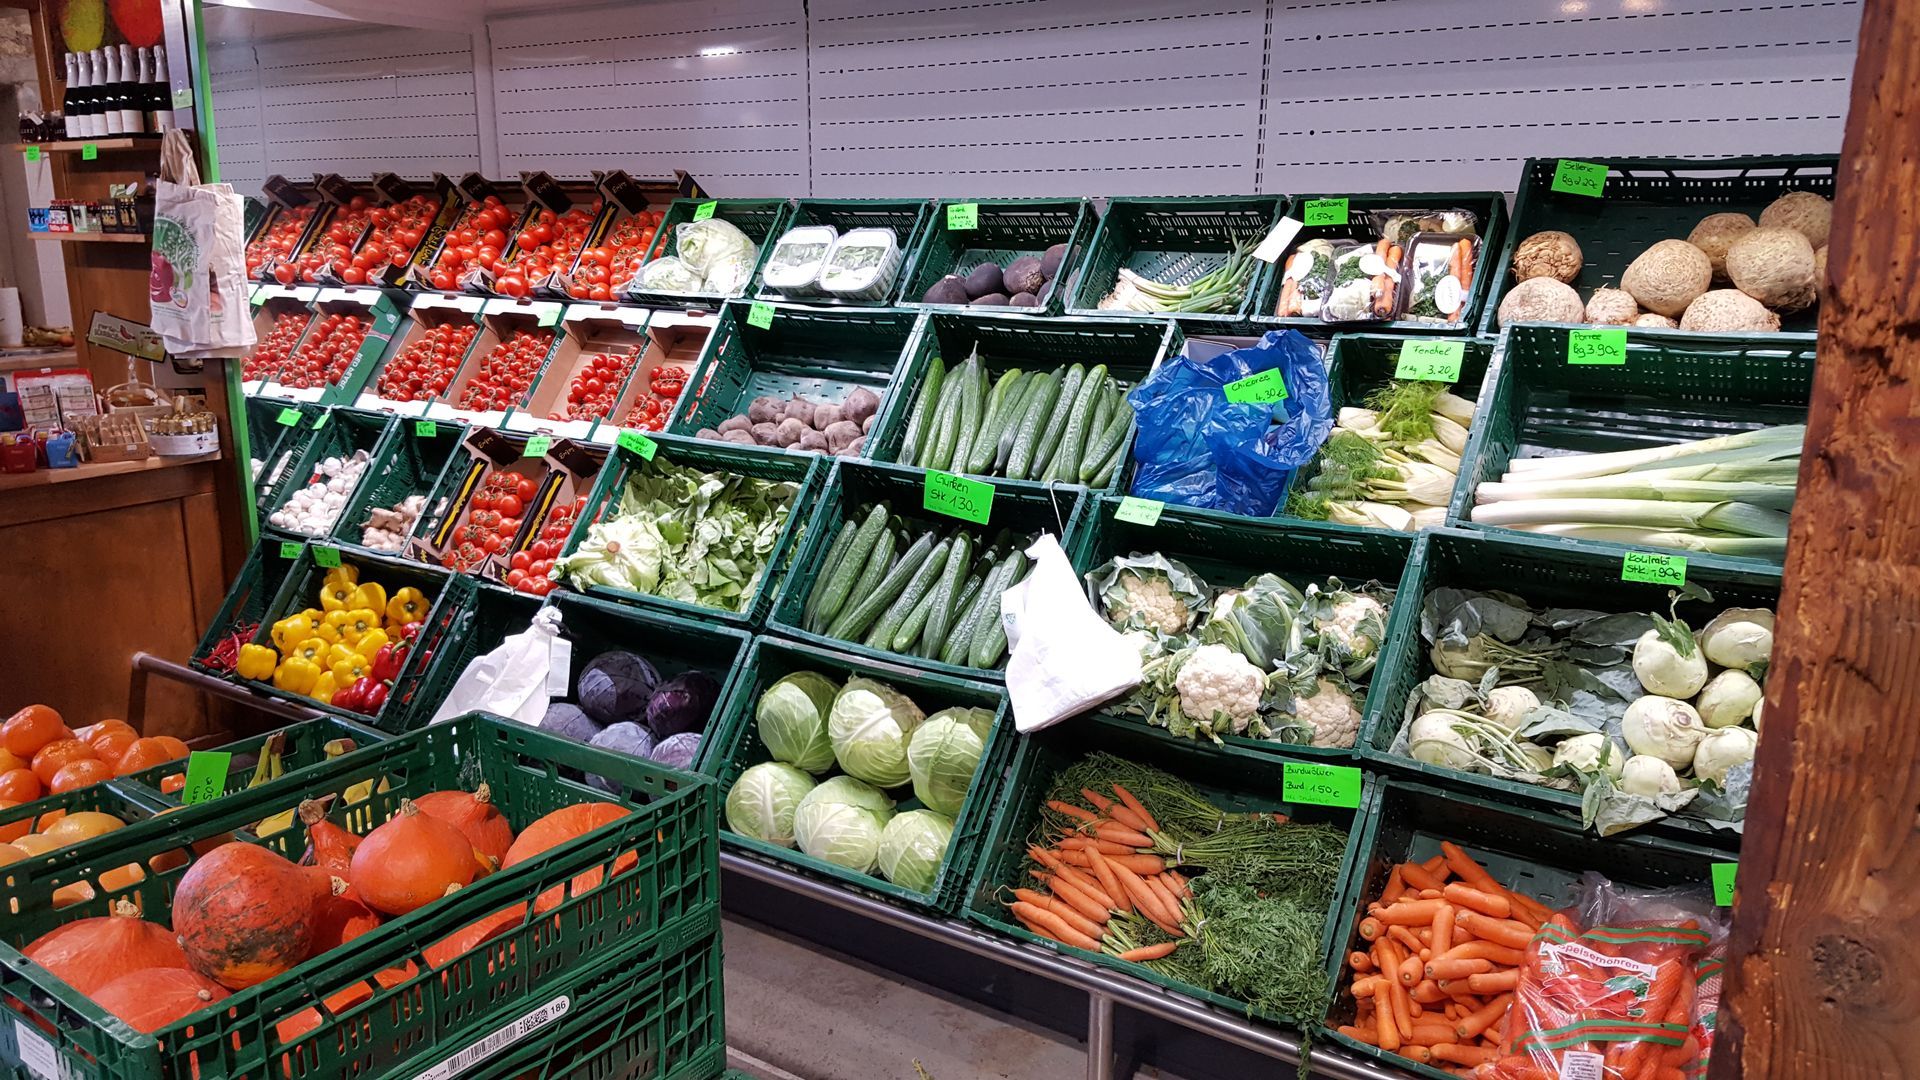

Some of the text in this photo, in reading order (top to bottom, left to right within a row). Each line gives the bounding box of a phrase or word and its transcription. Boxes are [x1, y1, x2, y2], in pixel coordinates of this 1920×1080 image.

[478, 437, 494, 449] Enjoy
[559, 447, 575, 460] Enjoy
[935, 472, 969, 494] Gurken
[550, 1000, 567, 1015] 186
